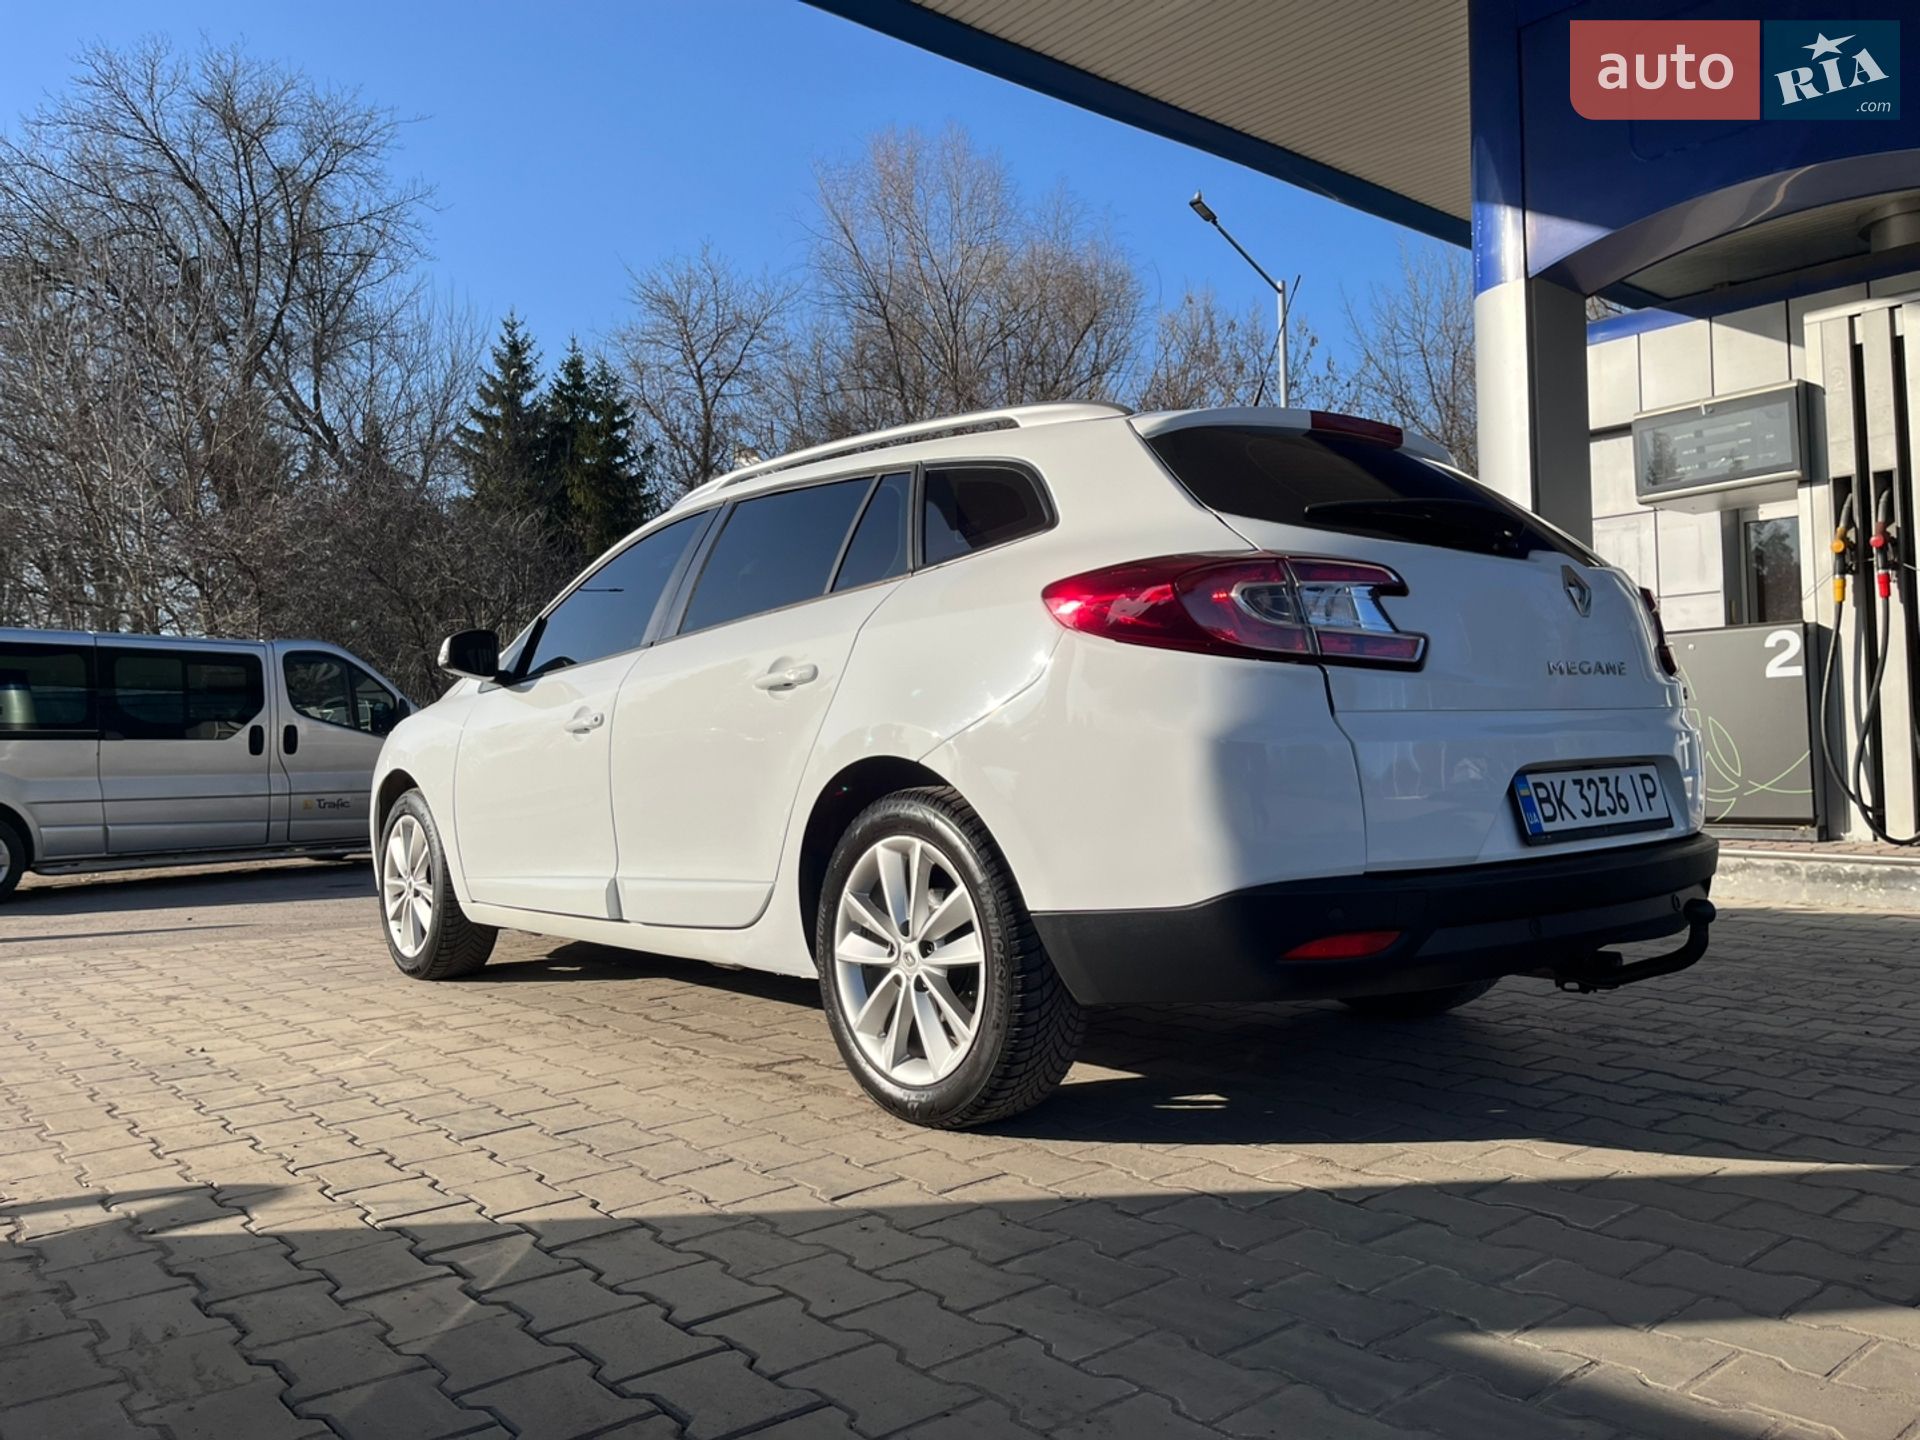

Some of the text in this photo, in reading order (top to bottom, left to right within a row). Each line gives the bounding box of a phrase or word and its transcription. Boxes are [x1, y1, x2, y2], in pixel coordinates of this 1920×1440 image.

[1764, 629, 1803, 679] 2
[1547, 660, 1627, 676] MEGANE
[315, 797, 352, 810] Trafic
[1532, 773, 1657, 823] BK 3236 IP
[1526, 810, 1541, 825] UA
